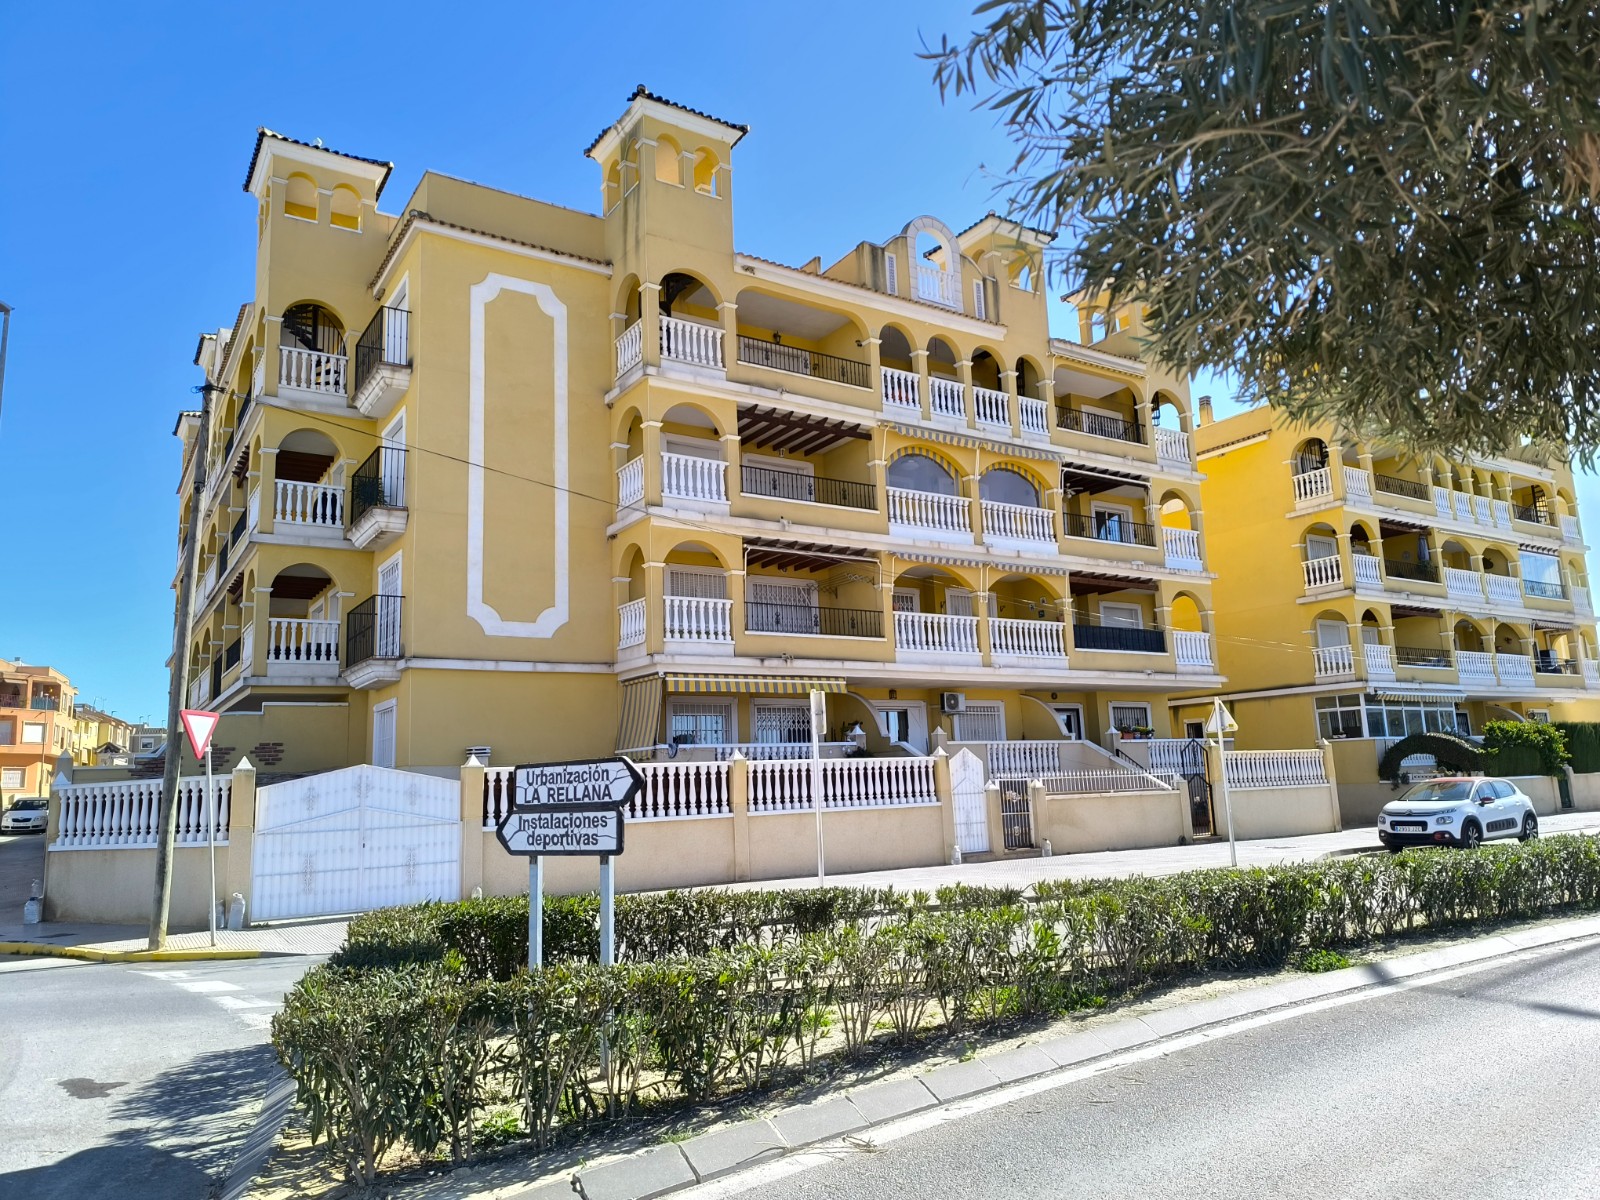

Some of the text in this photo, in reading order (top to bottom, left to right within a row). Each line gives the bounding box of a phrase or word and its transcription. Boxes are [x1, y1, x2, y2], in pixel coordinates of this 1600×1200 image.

[526, 766, 610, 786] Urbanización
[524, 784, 613, 804] LA RELLANA
[518, 814, 608, 831] Instalaciones
[526, 830, 599, 849] deportivas
